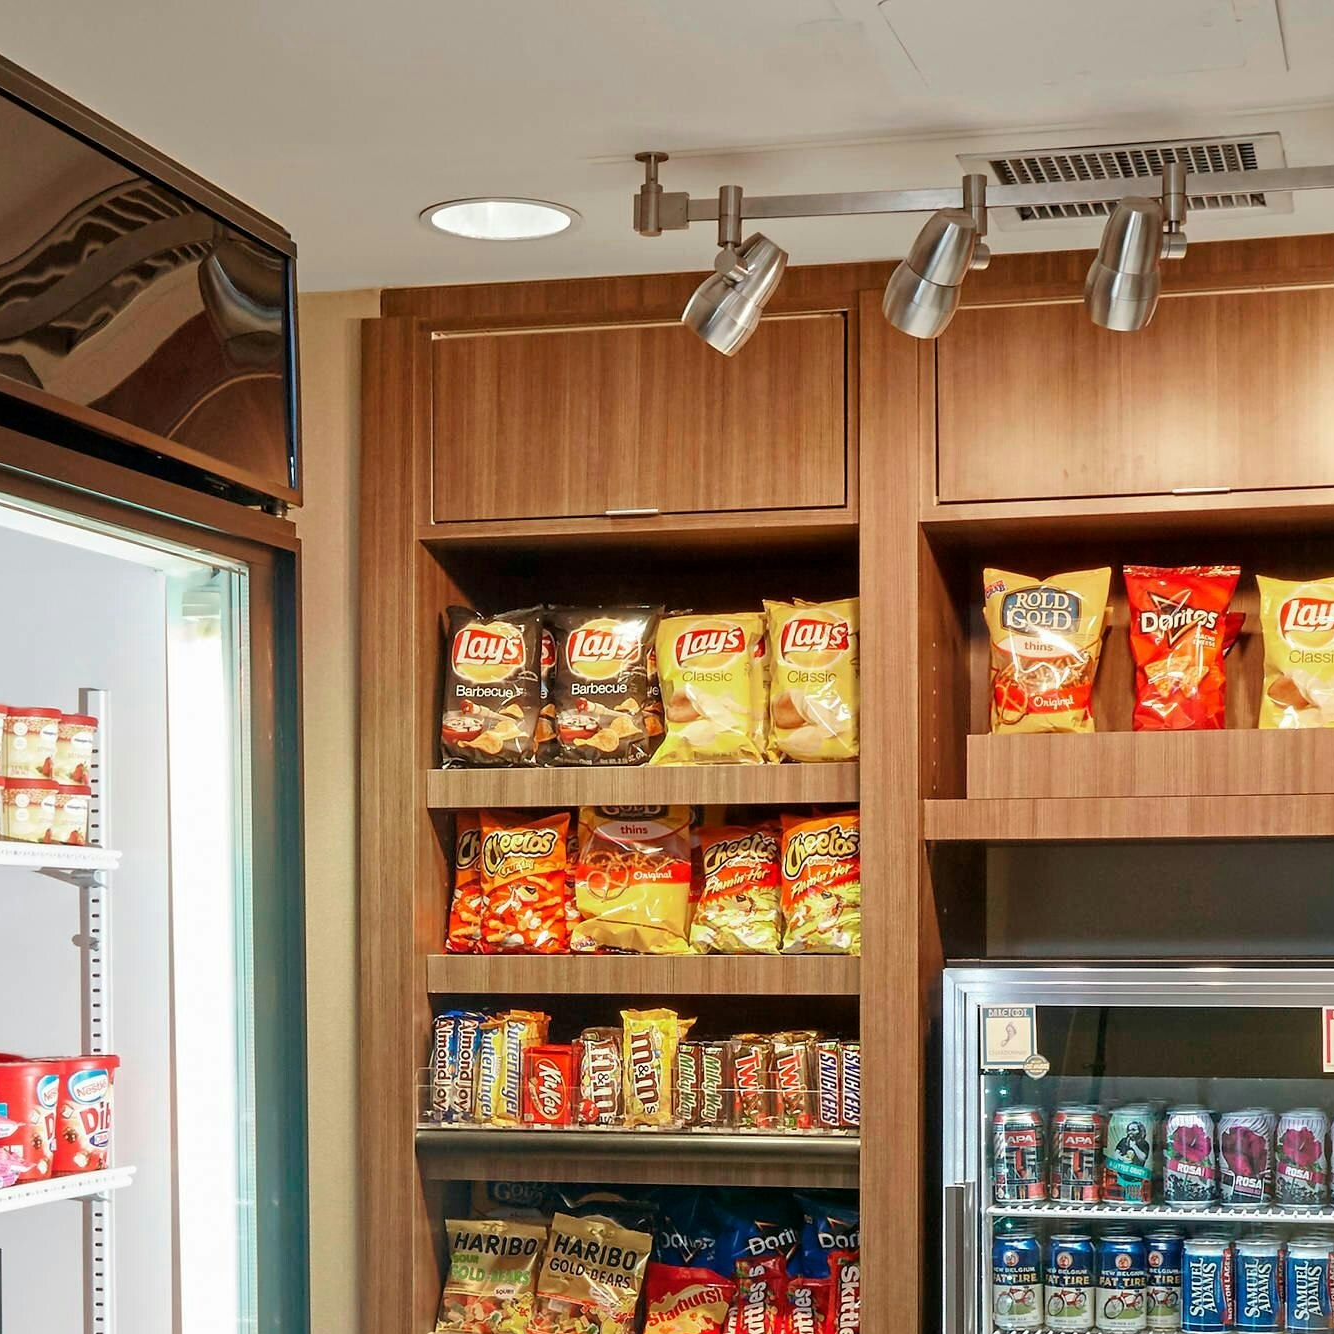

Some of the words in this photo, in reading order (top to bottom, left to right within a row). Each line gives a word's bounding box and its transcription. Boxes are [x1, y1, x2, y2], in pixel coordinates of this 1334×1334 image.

[1015, 591, 1071, 610] ROLD
[1006, 608, 1073, 632] GOLD
[1140, 608, 1219, 633] Doritos
[455, 629, 522, 666] Lay's
[570, 631, 638, 663] Lay's
[679, 627, 742, 662] Lay's
[784, 620, 849, 655] Lay's
[1024, 640, 1054, 653] thins
[682, 670, 733, 683] Classic
[787, 669, 837, 684] Classic
[455, 684, 514, 699] Barbecue
[571, 683, 628, 696] Barbecue
[1033, 694, 1075, 711] Original
[619, 824, 649, 835] thins
[482, 828, 559, 878] Cheetos
[783, 823, 860, 880] Cheetos
[633, 869, 673, 881] Original
[818, 1051, 839, 1126] SNICKERS
[1006, 1134, 1035, 1144] APA
[1065, 1137, 1093, 1145] APA
[1235, 1175, 1263, 1188] ROSA
[454, 1231, 539, 1257] HARIBO
[553, 1233, 639, 1272] HARIBO
[1064, 1275, 1091, 1286] TIRE
[1099, 1276, 1118, 1287] FAT
[1122, 1276, 1147, 1287] TIRE
[1154, 1274, 1181, 1284] TIRE
[1189, 1257, 1204, 1318] SAMUEL
[1203, 1262, 1218, 1314] ADAMS
[1244, 1258, 1260, 1319] SAMUEL
[1259, 1263, 1273, 1315] ADAMS
[1294, 1260, 1310, 1321] SAMUEL
[1309, 1265, 1324, 1317] ADAMS
[1225, 1281, 1233, 1321] BOSTON
